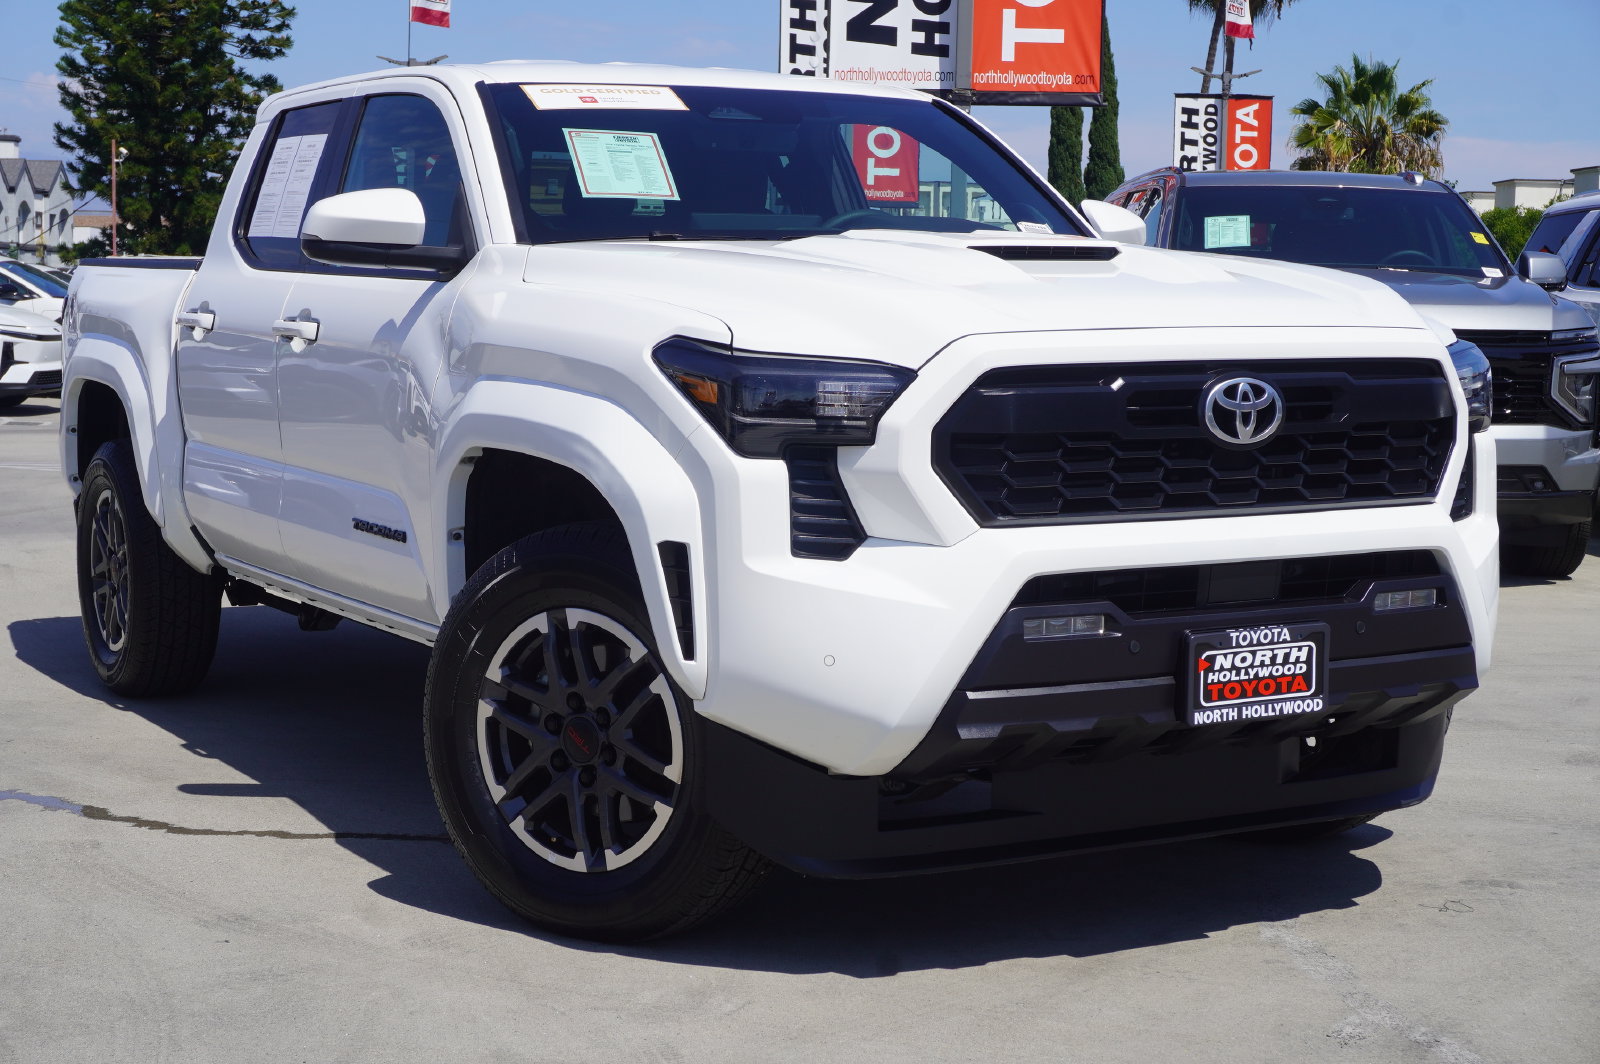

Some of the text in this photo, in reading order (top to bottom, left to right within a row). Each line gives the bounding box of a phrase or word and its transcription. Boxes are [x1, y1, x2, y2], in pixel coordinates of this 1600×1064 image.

[834, 66, 954, 85] northhollywoodtoyota.com
[973, 70, 1095, 88] northhollywoodtoyota.com
[1233, 102, 1259, 170] OTA
[867, 126, 901, 185] TO
[1229, 627, 1291, 647] TOYOTA
[1213, 646, 1309, 671] NORTH
[1207, 663, 1307, 684] HOLLYWOOD
[1207, 675, 1309, 701] TOYOTA
[1194, 698, 1323, 725] NORTH HOLLYWOOD
